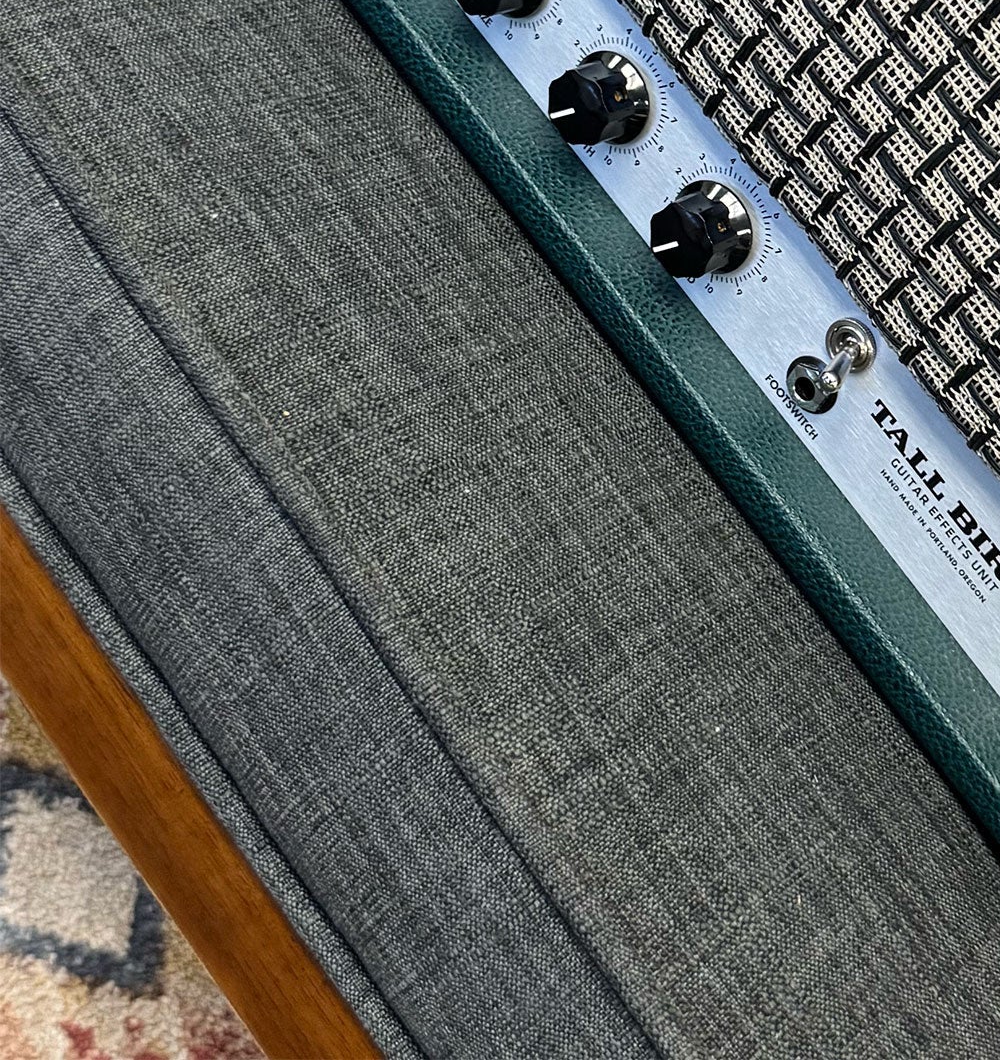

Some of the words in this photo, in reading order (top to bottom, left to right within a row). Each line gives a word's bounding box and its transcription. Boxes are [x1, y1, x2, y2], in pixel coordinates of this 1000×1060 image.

[704, 283, 714, 294] 10
[764, 374, 819, 441] FOOTSWITCH
[870, 398, 946, 502] TALL
[880, 468, 900, 492] HAND
[899, 492, 918, 517] MADE
[918, 516, 928, 528] IN
[958, 569, 987, 604] OREGON
[891, 458, 930, 507] GUITAR
[928, 505, 973, 560] EFFECTS
[971, 559, 999, 593] UNIT
